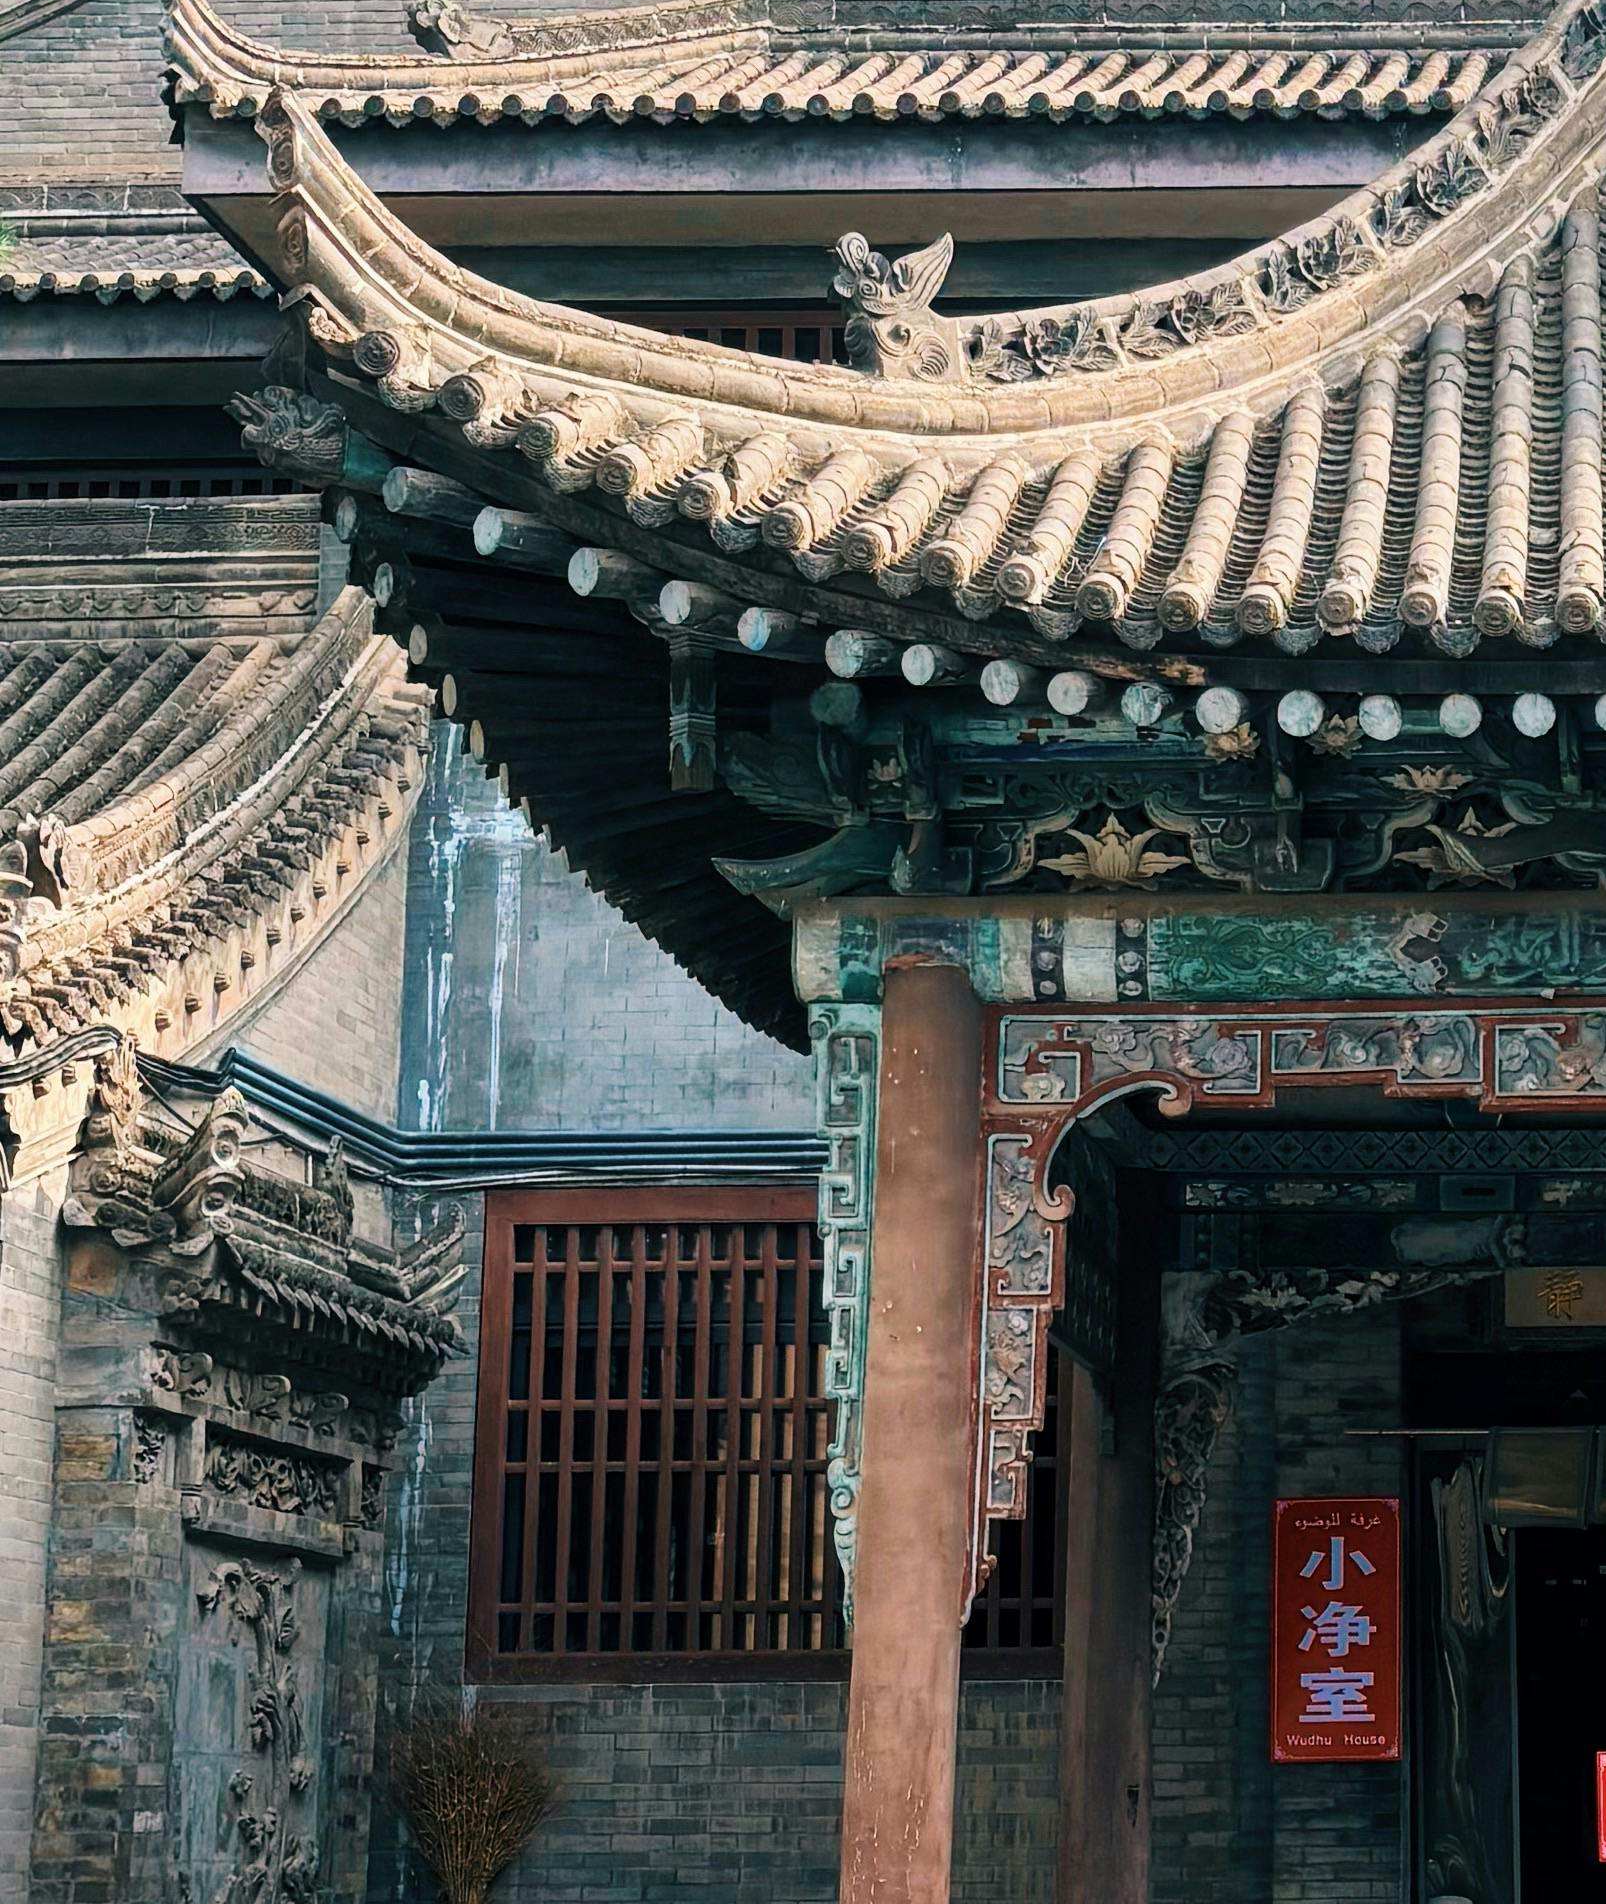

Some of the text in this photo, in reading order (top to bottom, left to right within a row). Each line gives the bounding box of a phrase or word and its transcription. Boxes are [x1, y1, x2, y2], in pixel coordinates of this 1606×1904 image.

[1298, 1536, 1377, 1723] 小净室
[1287, 1734, 1386, 1746] Wudhu House
